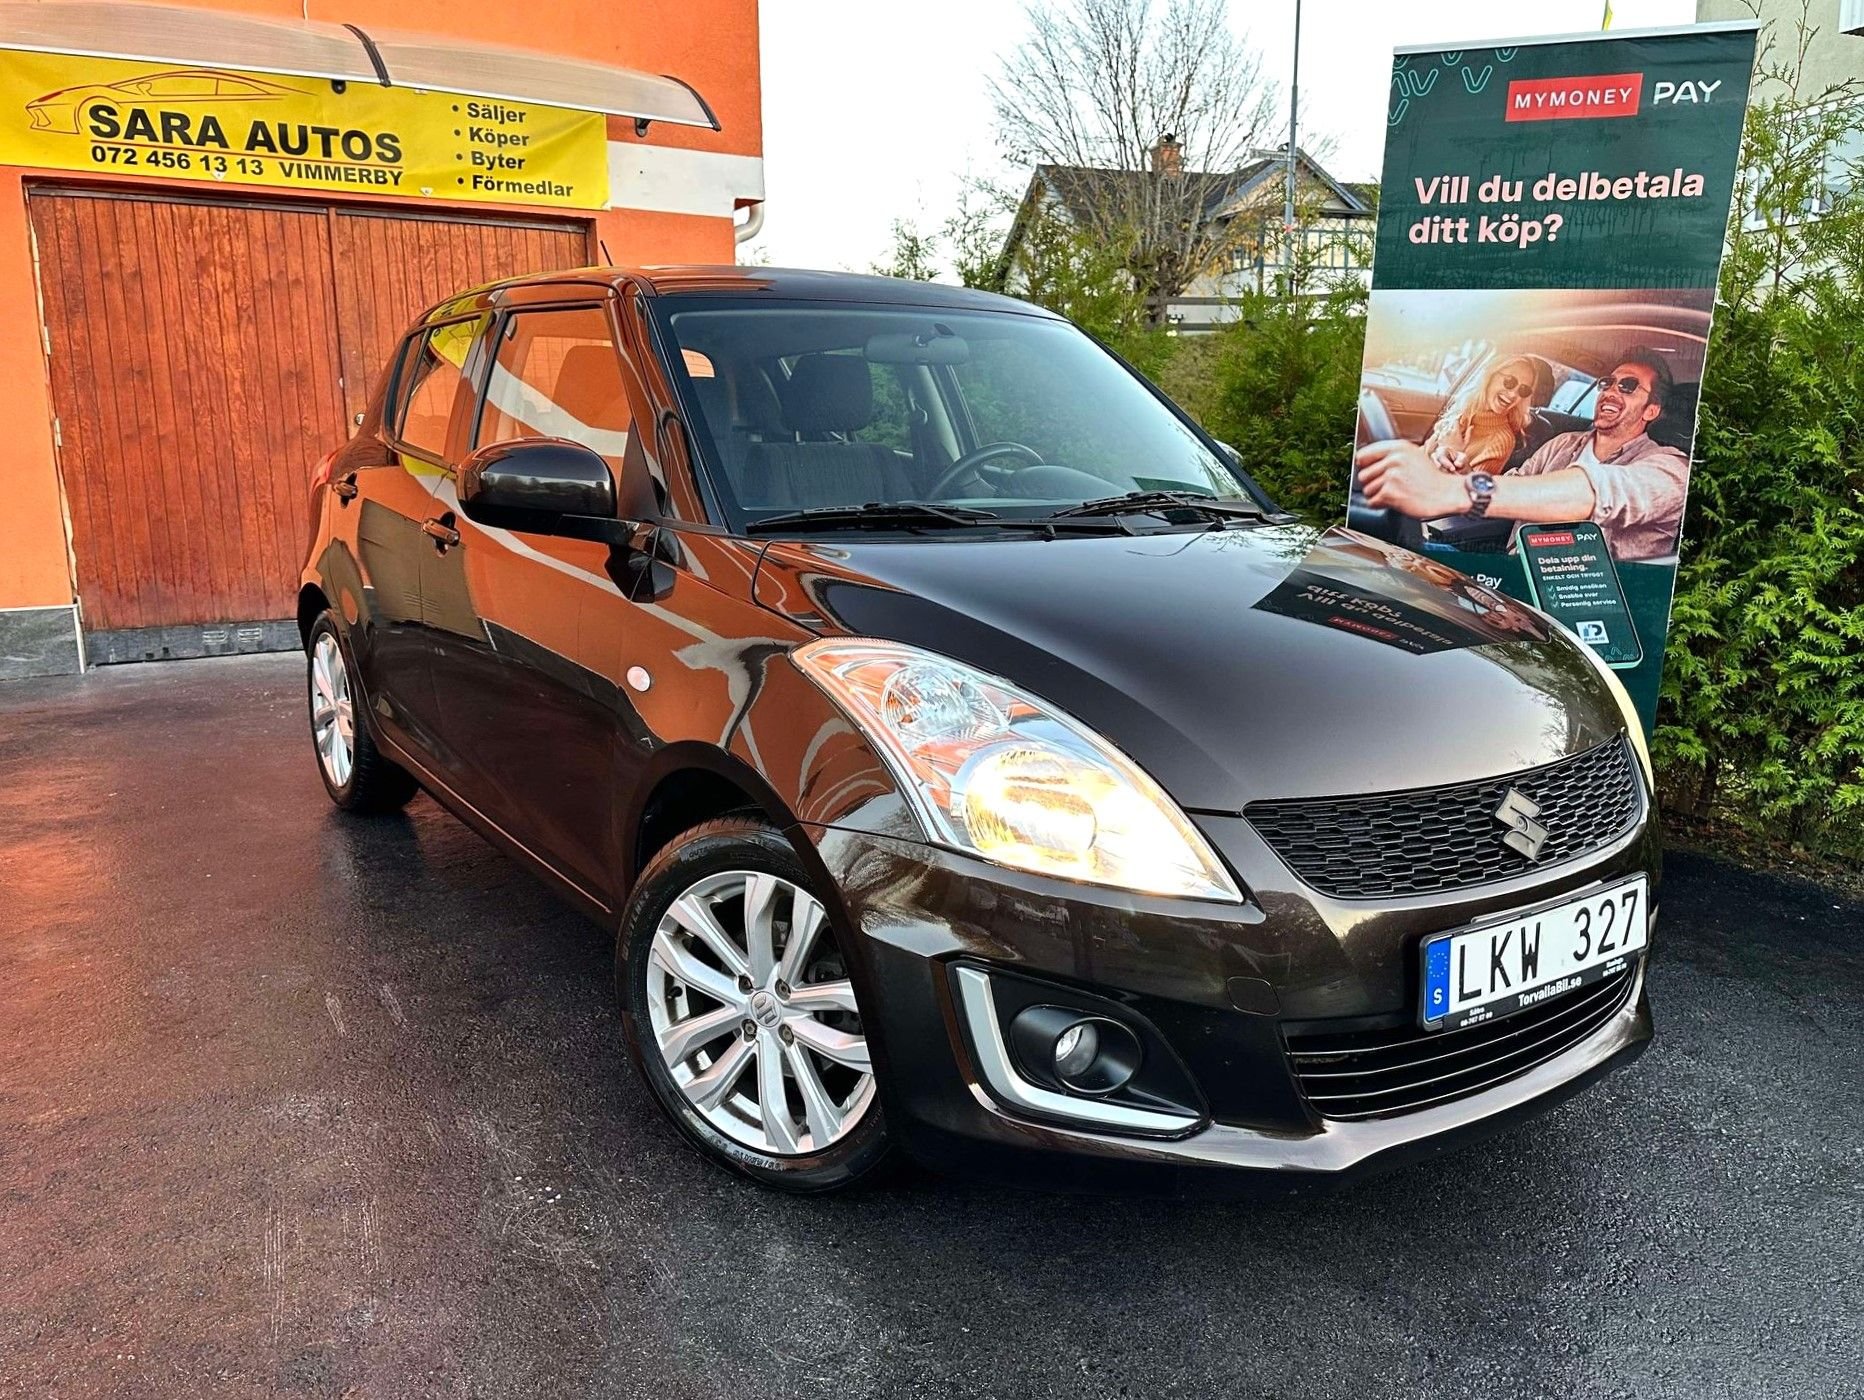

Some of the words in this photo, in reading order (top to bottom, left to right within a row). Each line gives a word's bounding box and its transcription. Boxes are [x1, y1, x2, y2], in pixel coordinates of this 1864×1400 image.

[1514, 87, 1633, 109] MYMONEY
[1653, 79, 1722, 105] PAY
[467, 102, 526, 125] Säljer
[88, 104, 230, 149] SARA
[244, 120, 403, 163] AUTOS
[469, 126, 530, 147] Köper
[91, 145, 138, 165] 072
[146, 150, 191, 170] 456
[199, 155, 228, 173] 13
[236, 158, 264, 176] 13
[278, 161, 403, 186] VIMMERBY
[471, 150, 526, 171] Byter
[472, 174, 573, 197] Förmedlar
[1414, 175, 1468, 204] Vill
[1478, 175, 1523, 202] du
[1532, 168, 1705, 201] delbetala
[1408, 214, 1469, 244] ditt
[1477, 213, 1564, 249] köp?
[1531, 535, 1571, 543] MYMONEY
[1577, 533, 1598, 541] PAY
[1538, 557, 1560, 565] Dela
[1561, 556, 1579, 564] upp
[1581, 554, 1597, 562] din
[1540, 564, 1588, 573] betalning.
[1476, 573, 1503, 590] Pay
[1433, 988, 1442, 1004] S
[1458, 921, 1541, 1002] LKW
[1572, 888, 1639, 962] 327
[1518, 976, 1582, 1006] TorvallaBil.se
